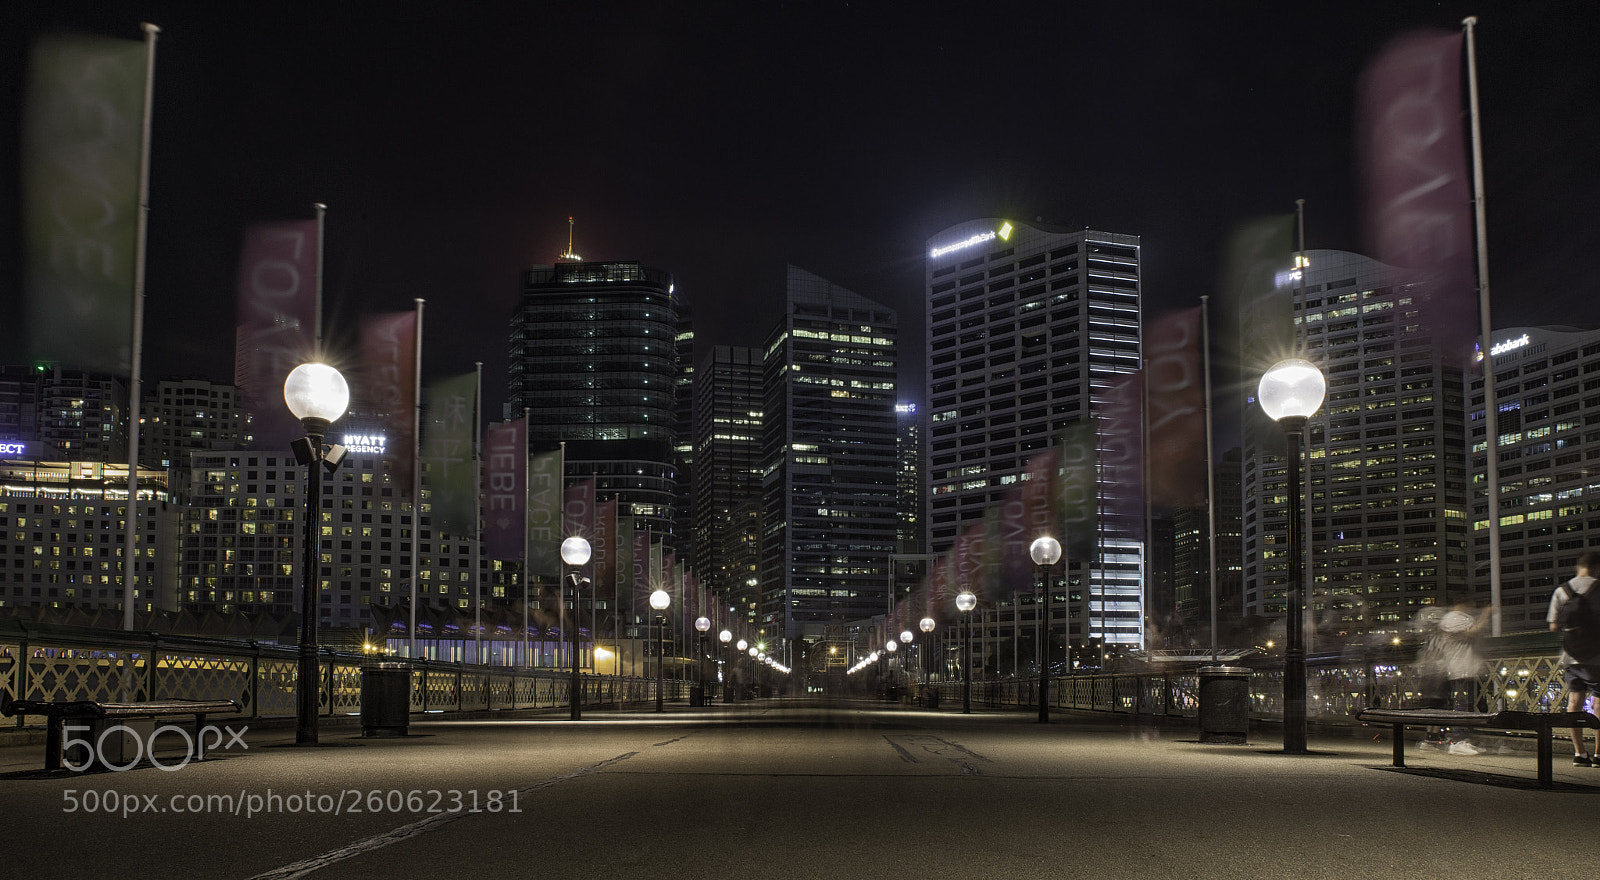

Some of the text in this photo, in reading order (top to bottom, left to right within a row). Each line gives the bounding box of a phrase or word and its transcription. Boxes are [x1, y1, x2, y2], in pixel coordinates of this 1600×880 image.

[1490, 333, 1530, 356] abobank
[344, 435, 386, 446] HYATT
[345, 445, 386, 454] REGENCY
